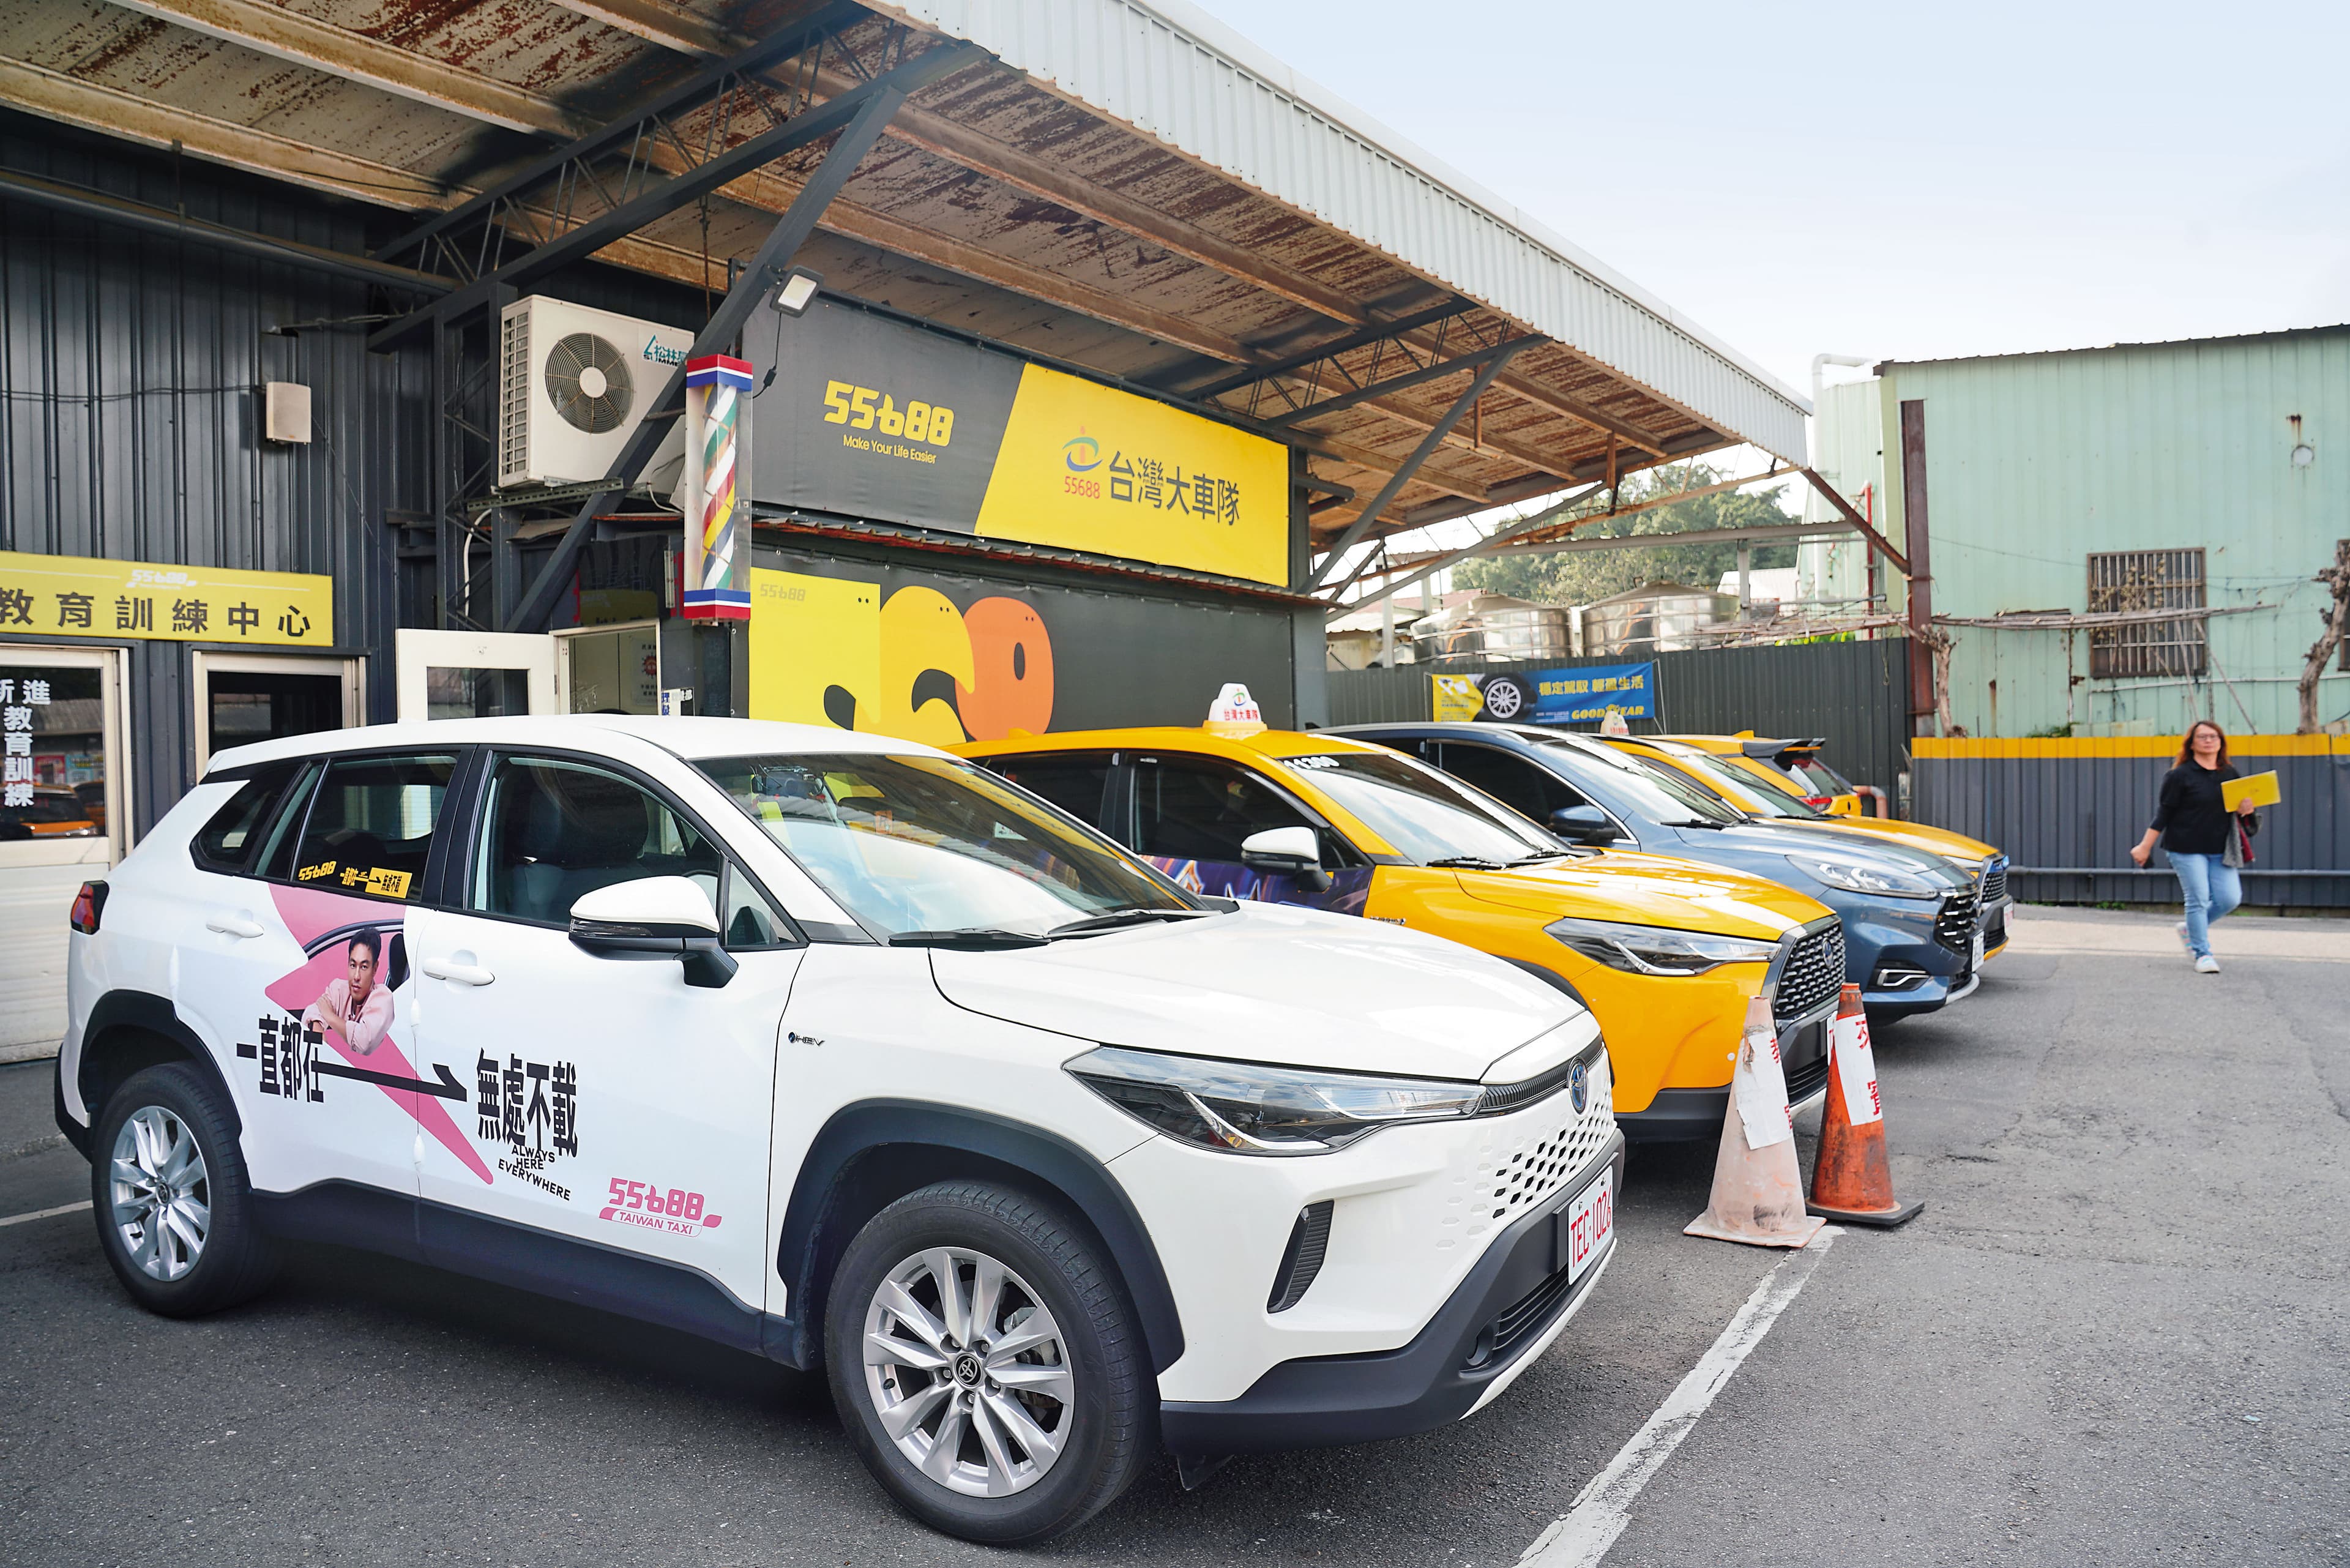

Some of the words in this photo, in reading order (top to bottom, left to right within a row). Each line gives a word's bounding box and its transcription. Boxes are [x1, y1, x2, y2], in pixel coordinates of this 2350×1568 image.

[824, 379, 954, 447] 55688
[843, 435, 869, 450] Make
[871, 440, 892, 455] Your
[893, 444, 909, 458] Life
[910, 448, 936, 464] Easier
[1064, 476, 1100, 499] 55688
[1110, 450, 1239, 526] 台灣大車隊
[132, 569, 187, 584] 55688
[760, 583, 805, 601] 55688
[0, 588, 311, 637] 教育訓練中心
[1224, 709, 1258, 720] 台灣大車隊
[4, 706, 34, 807] 教育訓練
[298, 861, 337, 881] 55688
[236, 1014, 324, 1102] 一直都在
[477, 1047, 578, 1157] 無處不載
[512, 1144, 555, 1163] ALWAYS
[516, 1158, 544, 1170] HERE
[498, 1159, 571, 1201] EVERYWHERE
[609, 1178, 704, 1221] 55688
[620, 1212, 663, 1229] TAIWAN
[667, 1221, 693, 1234] TAXI
